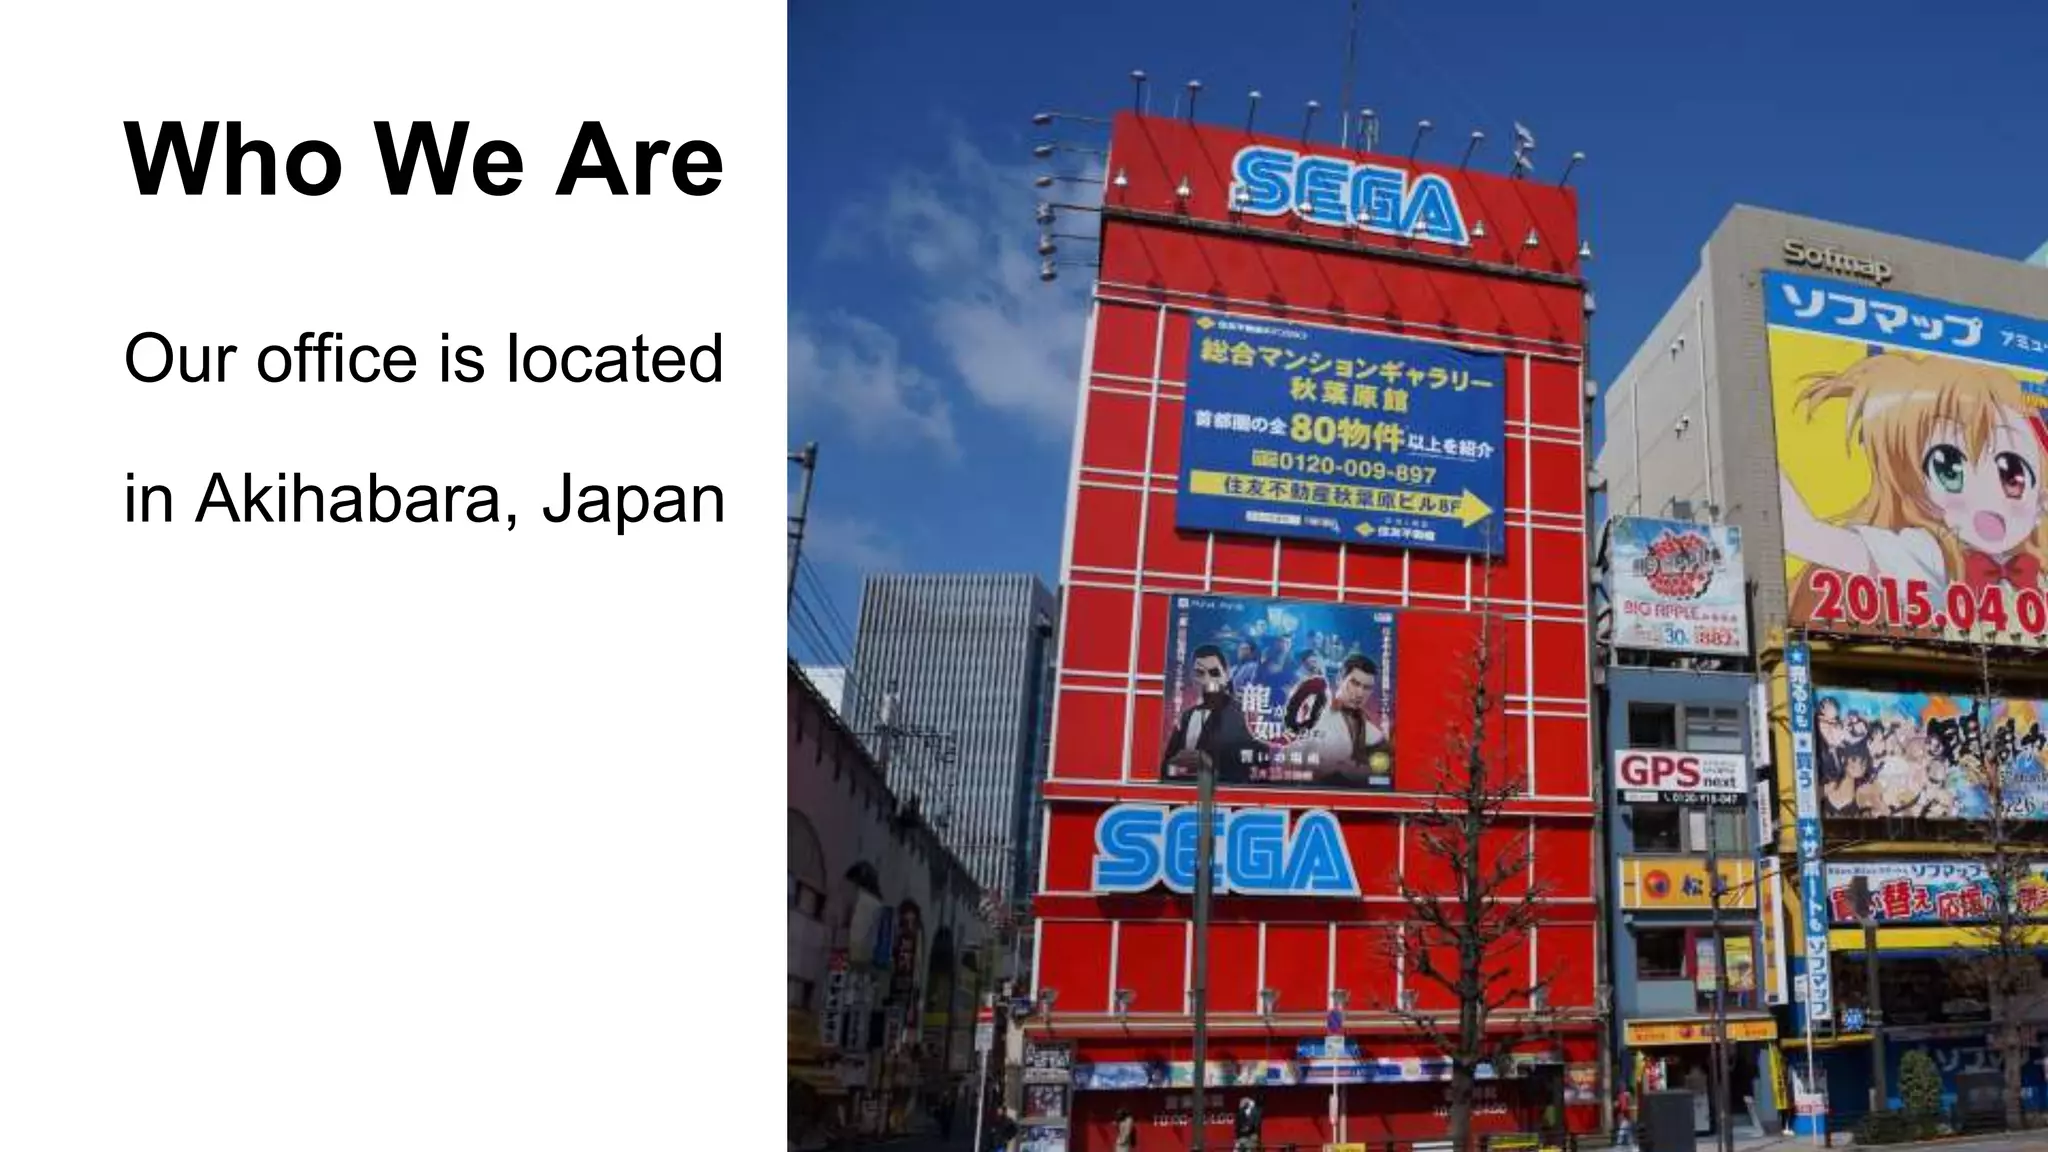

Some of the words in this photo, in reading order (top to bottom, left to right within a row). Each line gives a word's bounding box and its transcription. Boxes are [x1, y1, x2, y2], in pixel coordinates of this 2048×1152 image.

[1230, 145, 1470, 246] SEGA
[1784, 238, 1892, 284] Sofmap
[1781, 283, 1983, 347] ソフマップ
[1201, 338, 1494, 392] 総合マンションギャラリー
[1290, 376, 1409, 414] 秋葉原館
[1280, 452, 1437, 484] 0120-009-897
[1623, 600, 1651, 617] BIG
[2016, 587, 2048, 635] 0
[1620, 755, 1700, 788] GPS
[1704, 776, 1737, 789] next
[1092, 804, 1361, 897] SEGA
